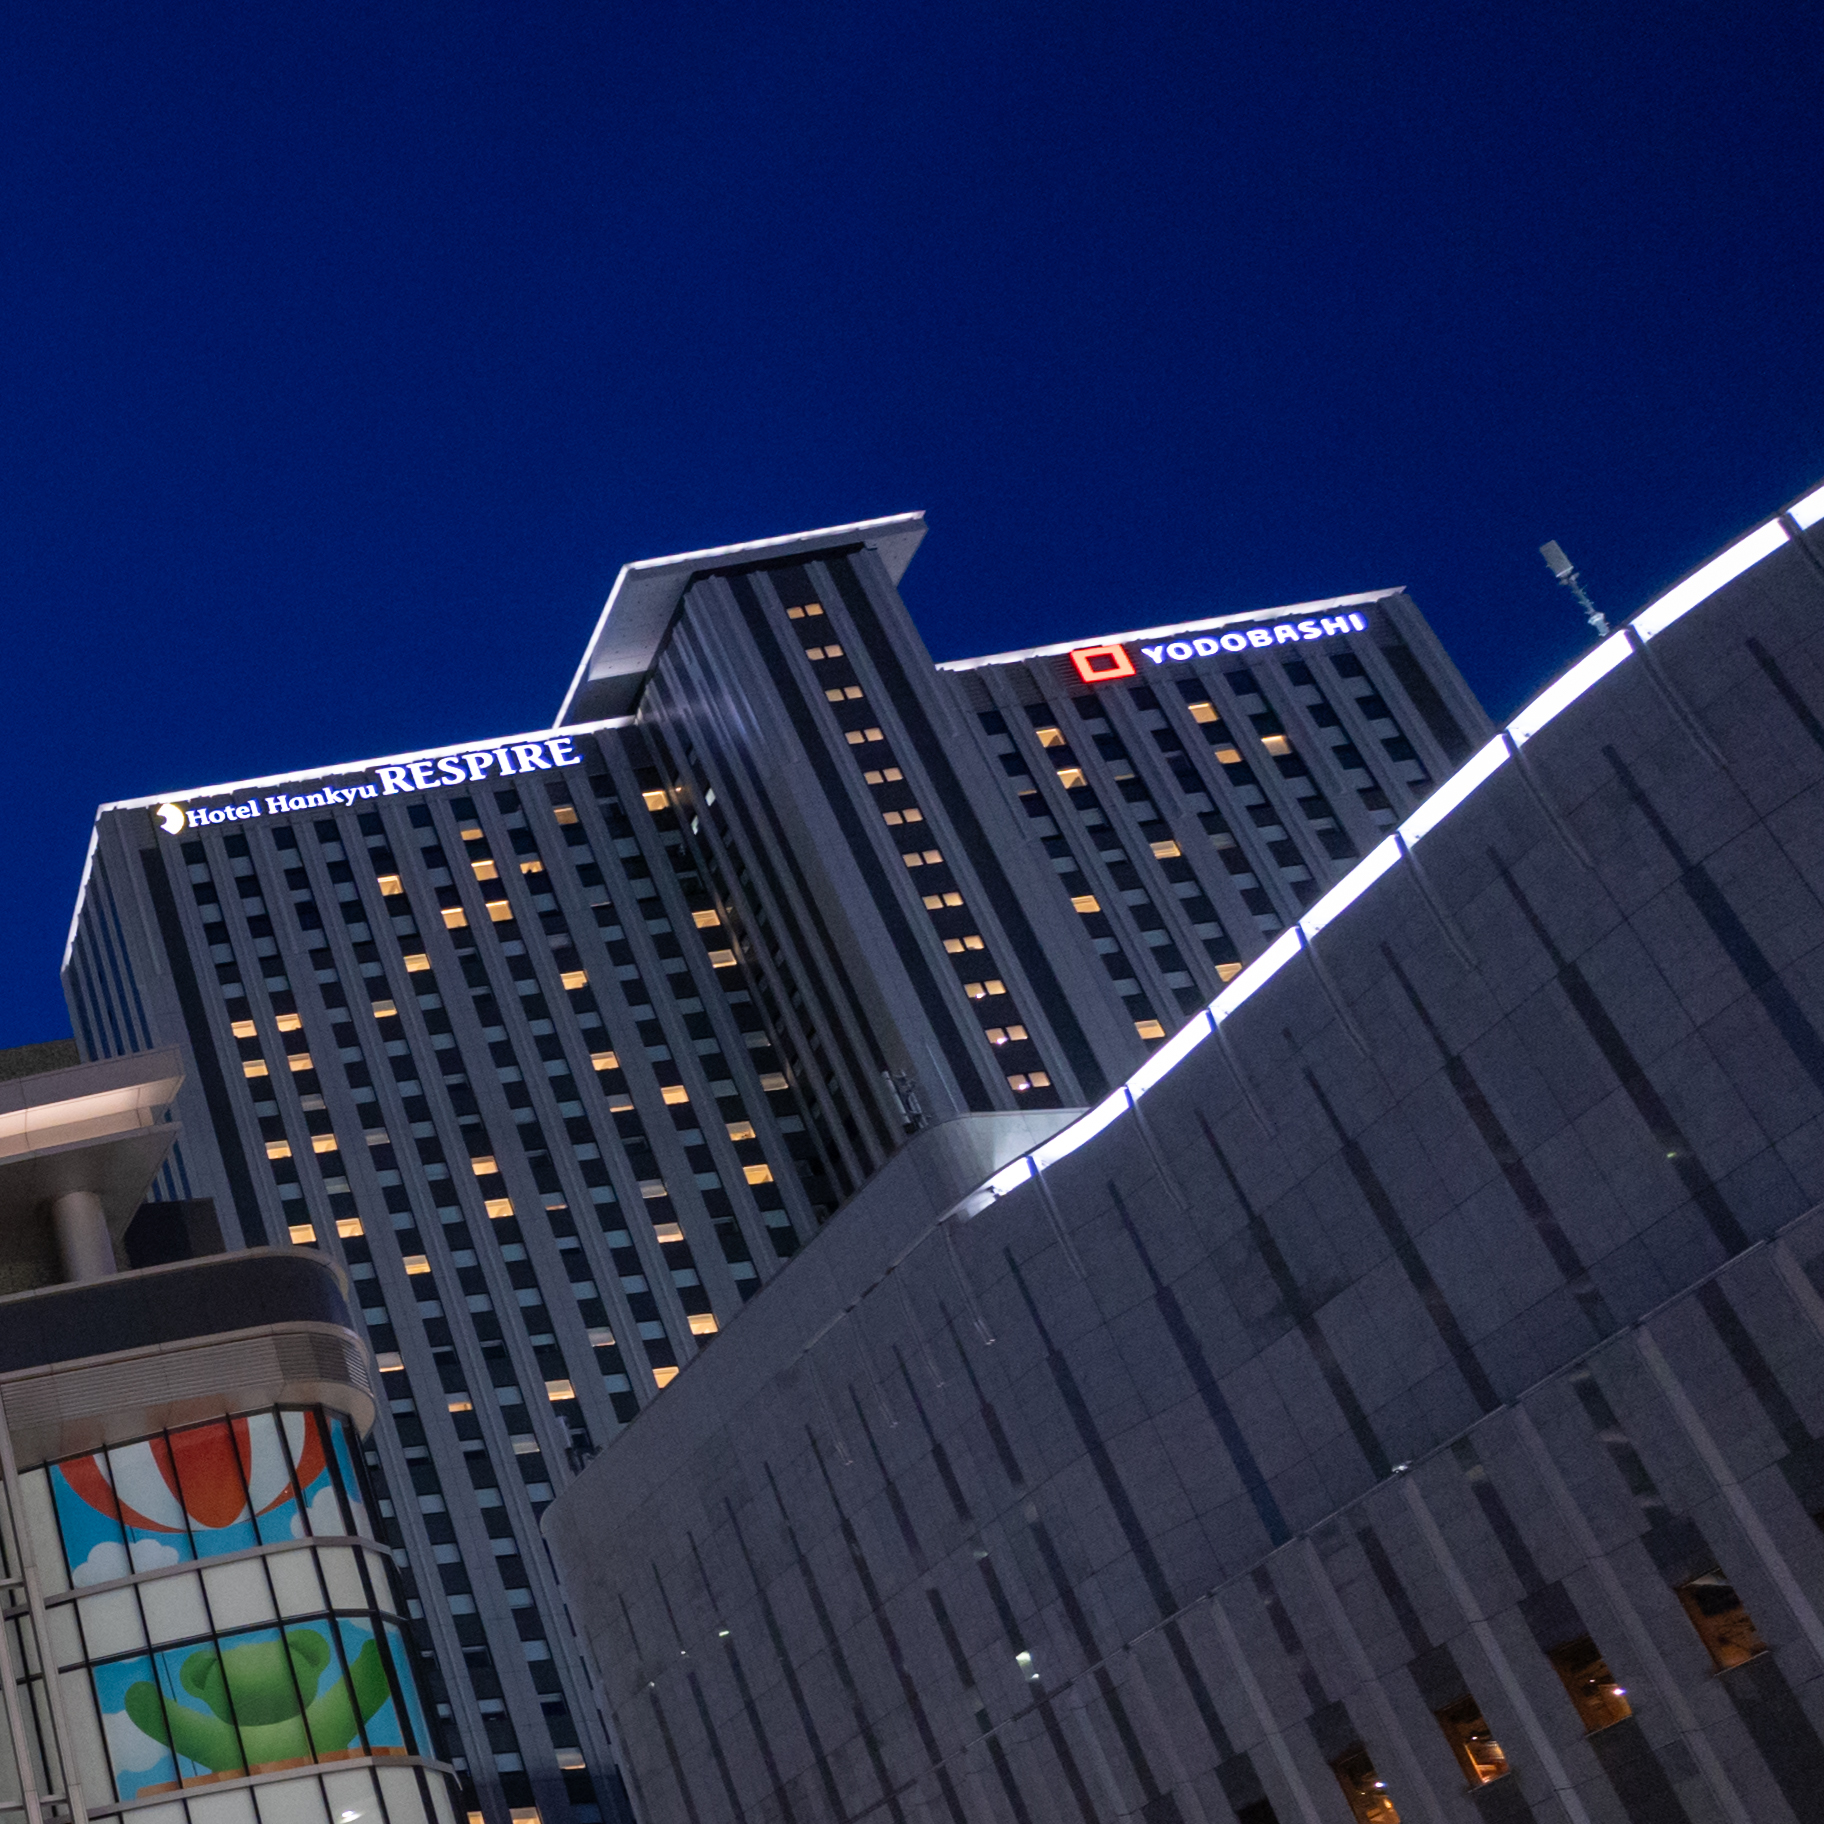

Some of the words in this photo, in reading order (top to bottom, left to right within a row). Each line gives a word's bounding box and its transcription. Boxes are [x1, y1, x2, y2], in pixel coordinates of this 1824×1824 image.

[1141, 611, 1367, 665] YODOBASHI
[185, 800, 262, 829] Hotel
[266, 782, 378, 816] Hankyu
[374, 735, 583, 797] RESPIRE
